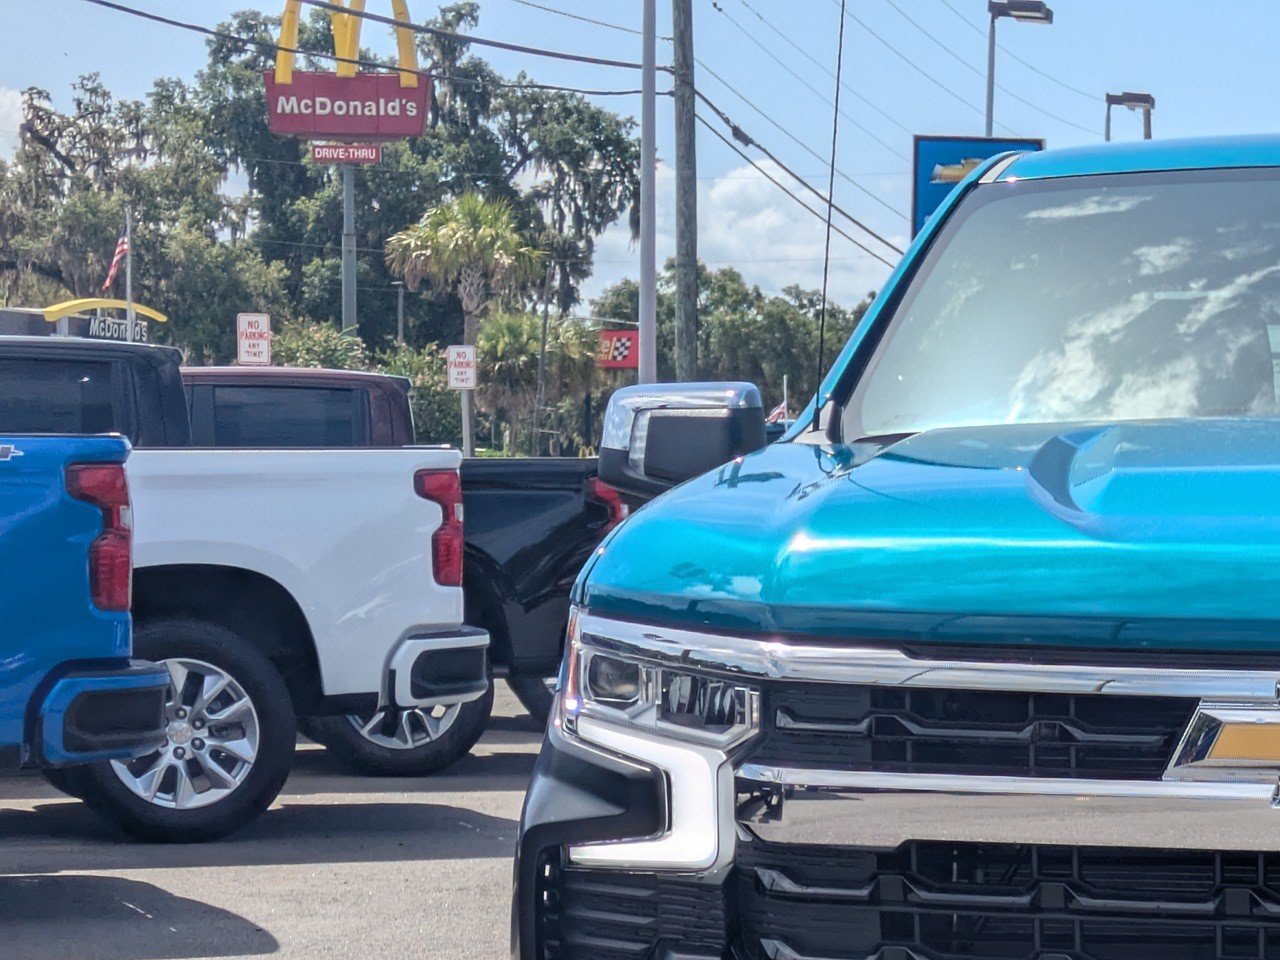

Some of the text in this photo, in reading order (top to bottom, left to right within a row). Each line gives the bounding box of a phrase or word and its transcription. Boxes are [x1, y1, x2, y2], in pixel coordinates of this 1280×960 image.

[276, 95, 418, 117] McDonald's
[314, 147, 376, 159] DRIVE-THRU
[89, 317, 148, 342] McDonlds
[247, 320, 260, 330] NO
[240, 331, 268, 341] PARKING
[456, 351, 467, 360] NO
